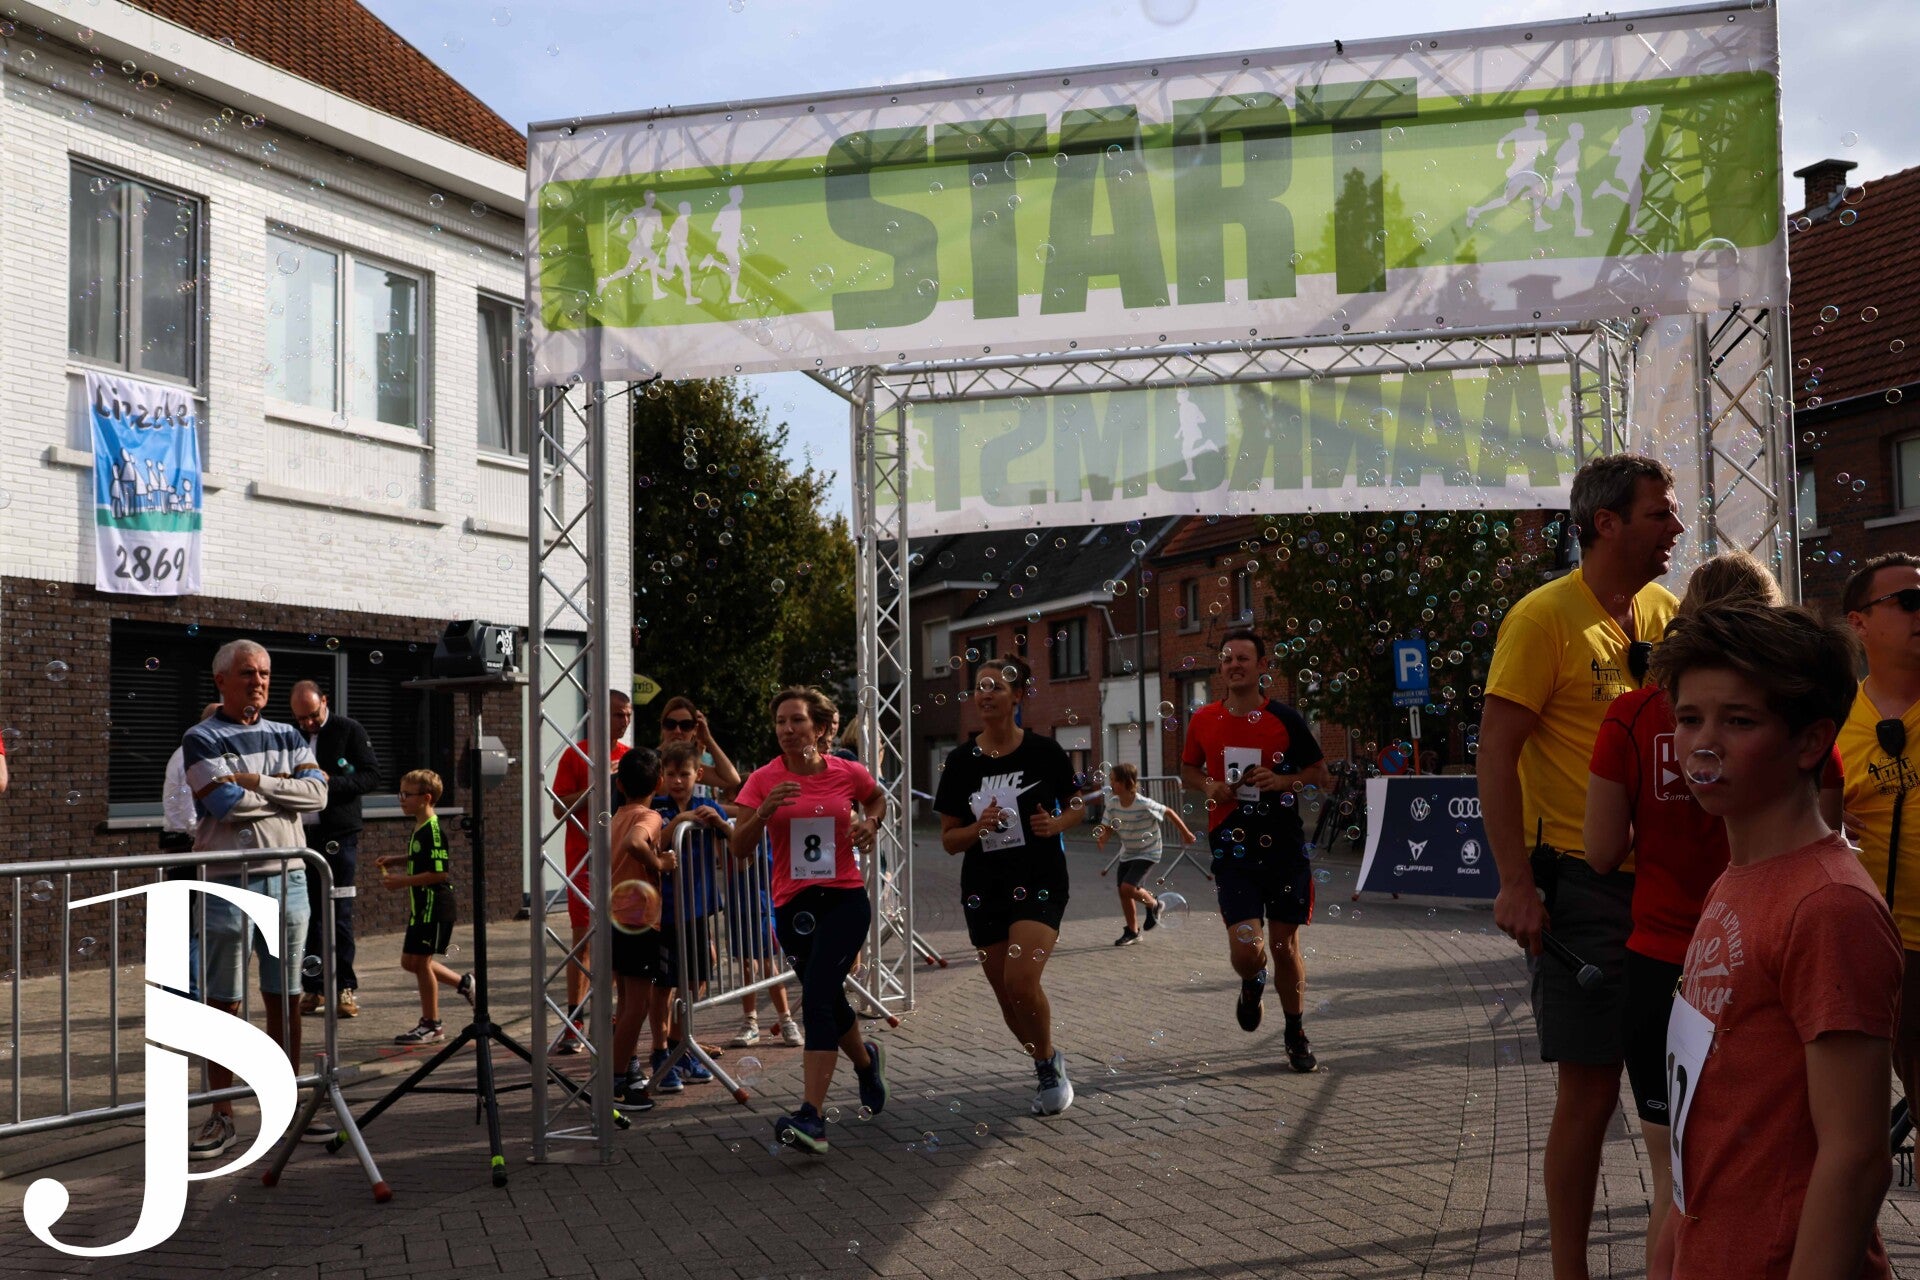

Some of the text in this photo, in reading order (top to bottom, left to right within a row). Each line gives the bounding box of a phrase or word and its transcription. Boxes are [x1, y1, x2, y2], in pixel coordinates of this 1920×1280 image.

[825, 77, 1418, 331] START
[114, 544, 185, 582] 2869
[1398, 647, 1422, 682] P
[980, 770, 1025, 793] NIKE
[804, 834, 821, 862] 8
